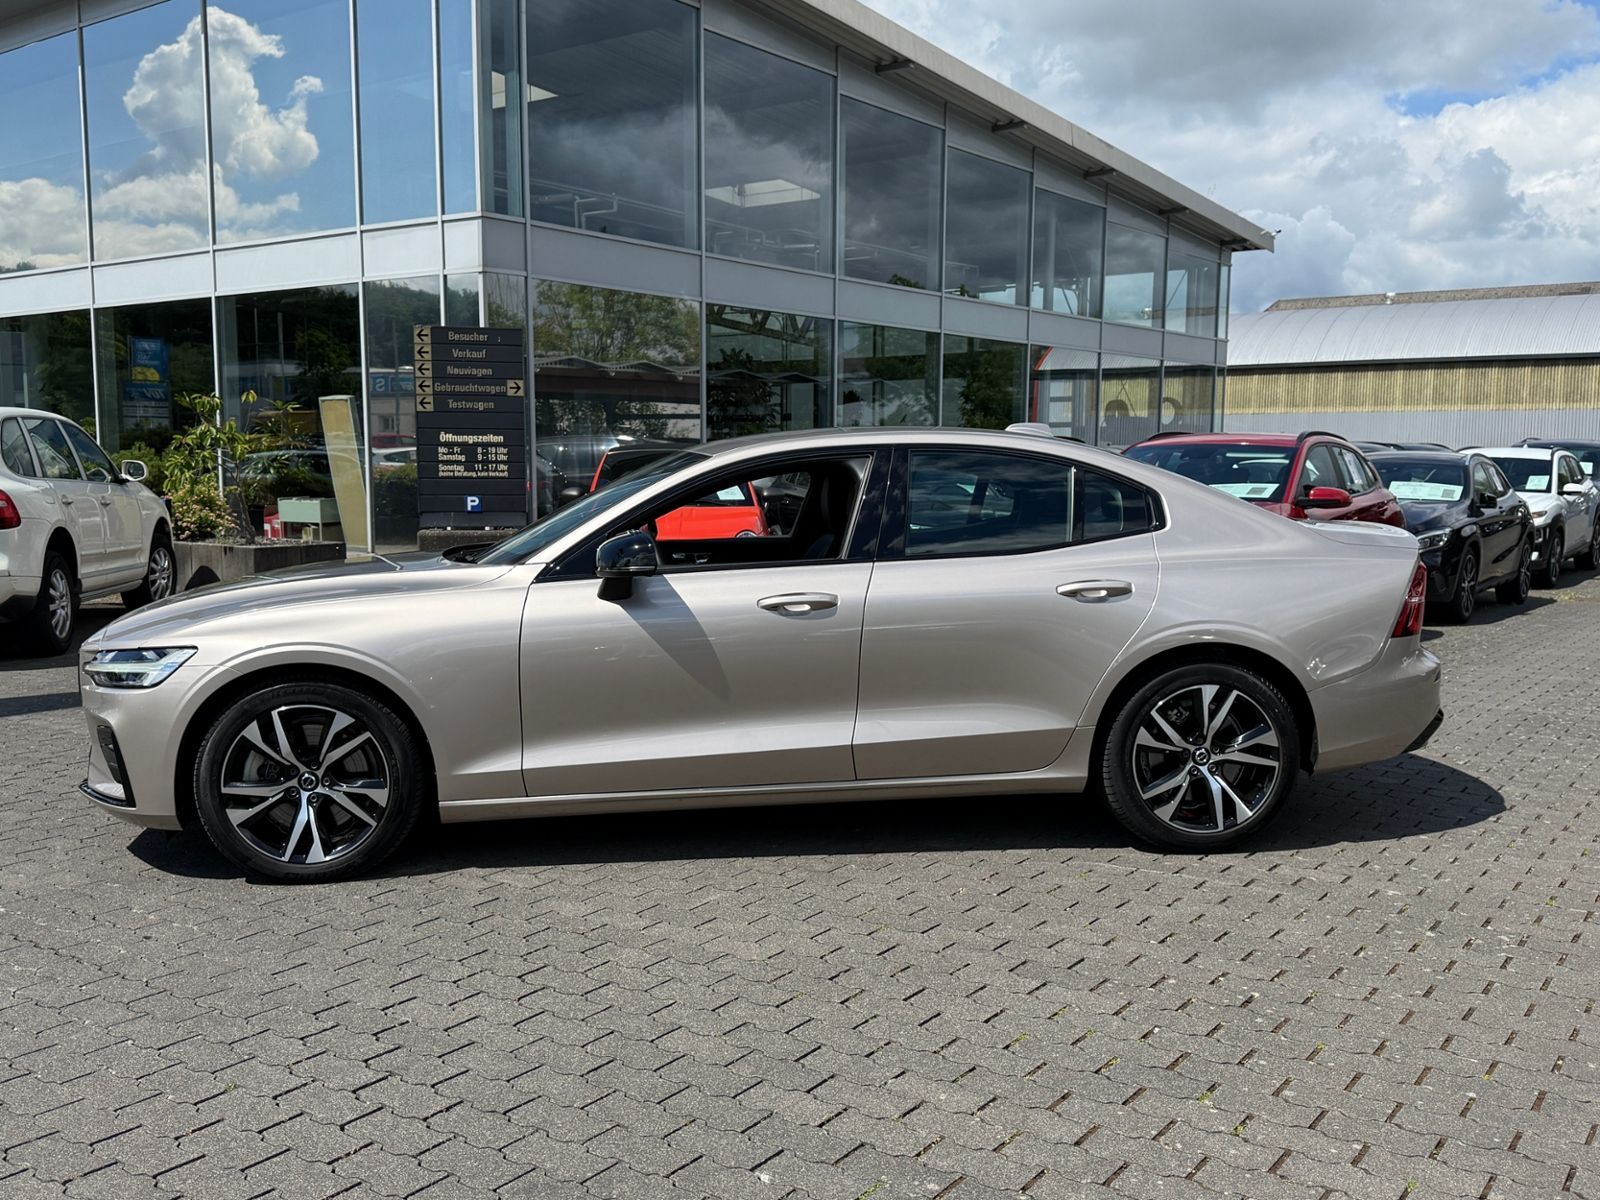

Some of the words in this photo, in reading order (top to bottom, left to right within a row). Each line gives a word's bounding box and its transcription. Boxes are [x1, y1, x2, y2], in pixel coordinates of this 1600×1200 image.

[448, 331, 488, 341] Besucher
[452, 348, 486, 358] Verkauf
[446, 366, 492, 376] Neuwagen
[434, 382, 506, 395] Gebrauchtwagen
[448, 400, 494, 410] Testwagen
[440, 432, 504, 444] Öffnungszeiten
[467, 496, 479, 510] P
